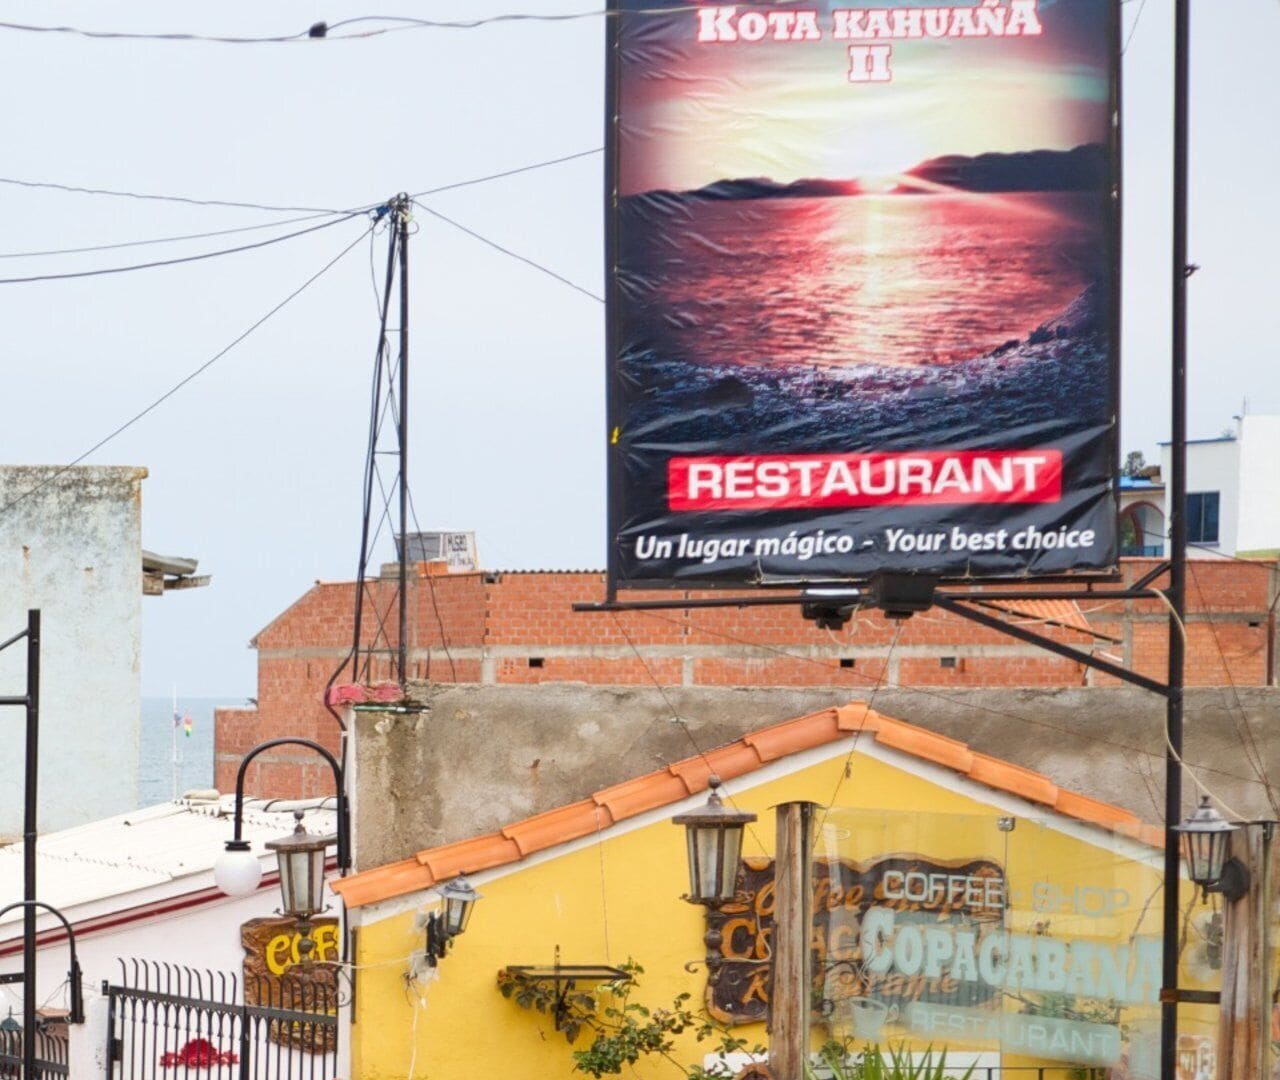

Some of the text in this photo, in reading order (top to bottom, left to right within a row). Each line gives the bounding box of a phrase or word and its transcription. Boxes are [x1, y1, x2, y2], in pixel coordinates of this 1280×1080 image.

[697, 0, 1042, 42] KOTA KAHUAÑA
[848, 44, 892, 82] II
[687, 456, 1046, 500] RESTAURANT
[635, 535, 671, 560] Un
[678, 534, 749, 565] lugar
[754, 530, 854, 561] mágico
[885, 528, 952, 553] Your
[956, 526, 1013, 551] best
[1016, 525, 1095, 549] choice
[883, 870, 1003, 908] COFFEE
[1032, 882, 1131, 918] SHOP
[863, 907, 1164, 1005] COPACABANA
[911, 1008, 1114, 1056] RESTAURANT
